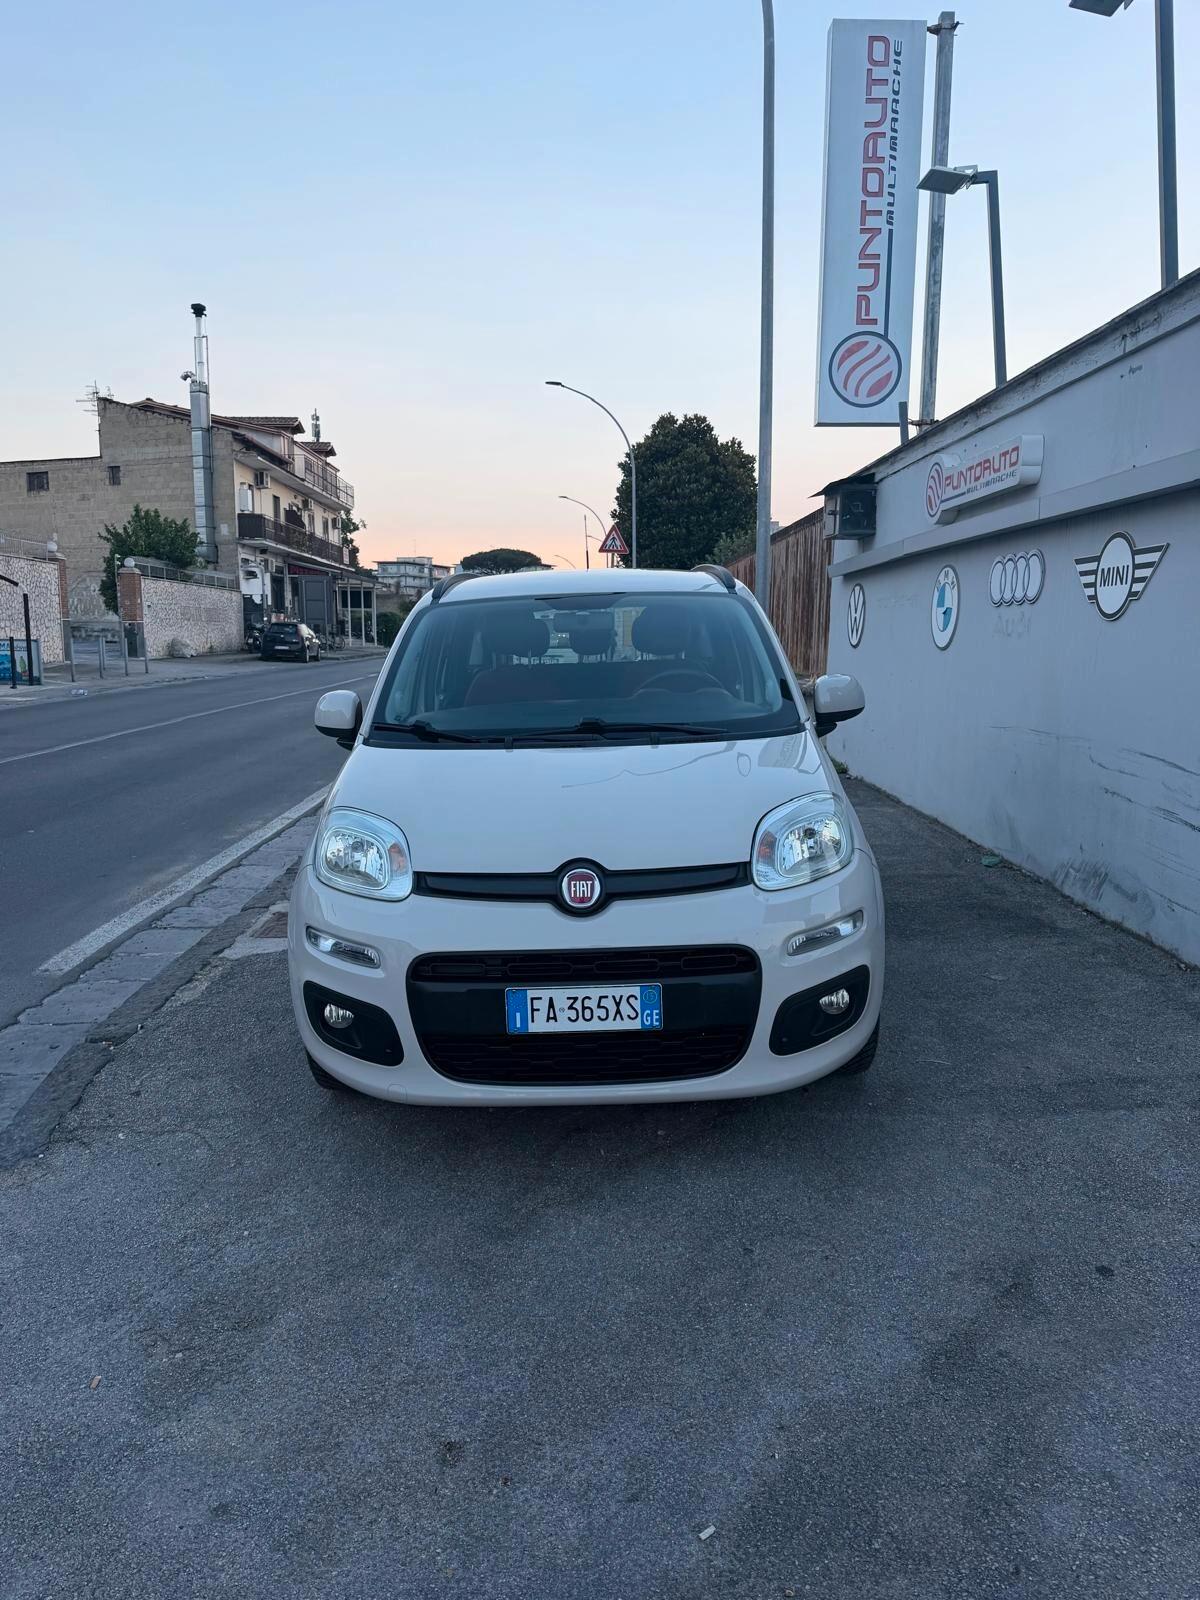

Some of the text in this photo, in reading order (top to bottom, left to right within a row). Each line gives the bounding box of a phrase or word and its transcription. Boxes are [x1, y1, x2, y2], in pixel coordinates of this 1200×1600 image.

[885, 39, 904, 227] MULTIMARCHE
[856, 35, 892, 325] PUNTOAUTO
[944, 445, 1020, 494] PUNTOAUTO
[966, 470, 1017, 495] MULTIMARCHE
[1099, 564, 1130, 588] MINI
[571, 880, 593, 898] FIAT
[643, 1009, 660, 1026] GE
